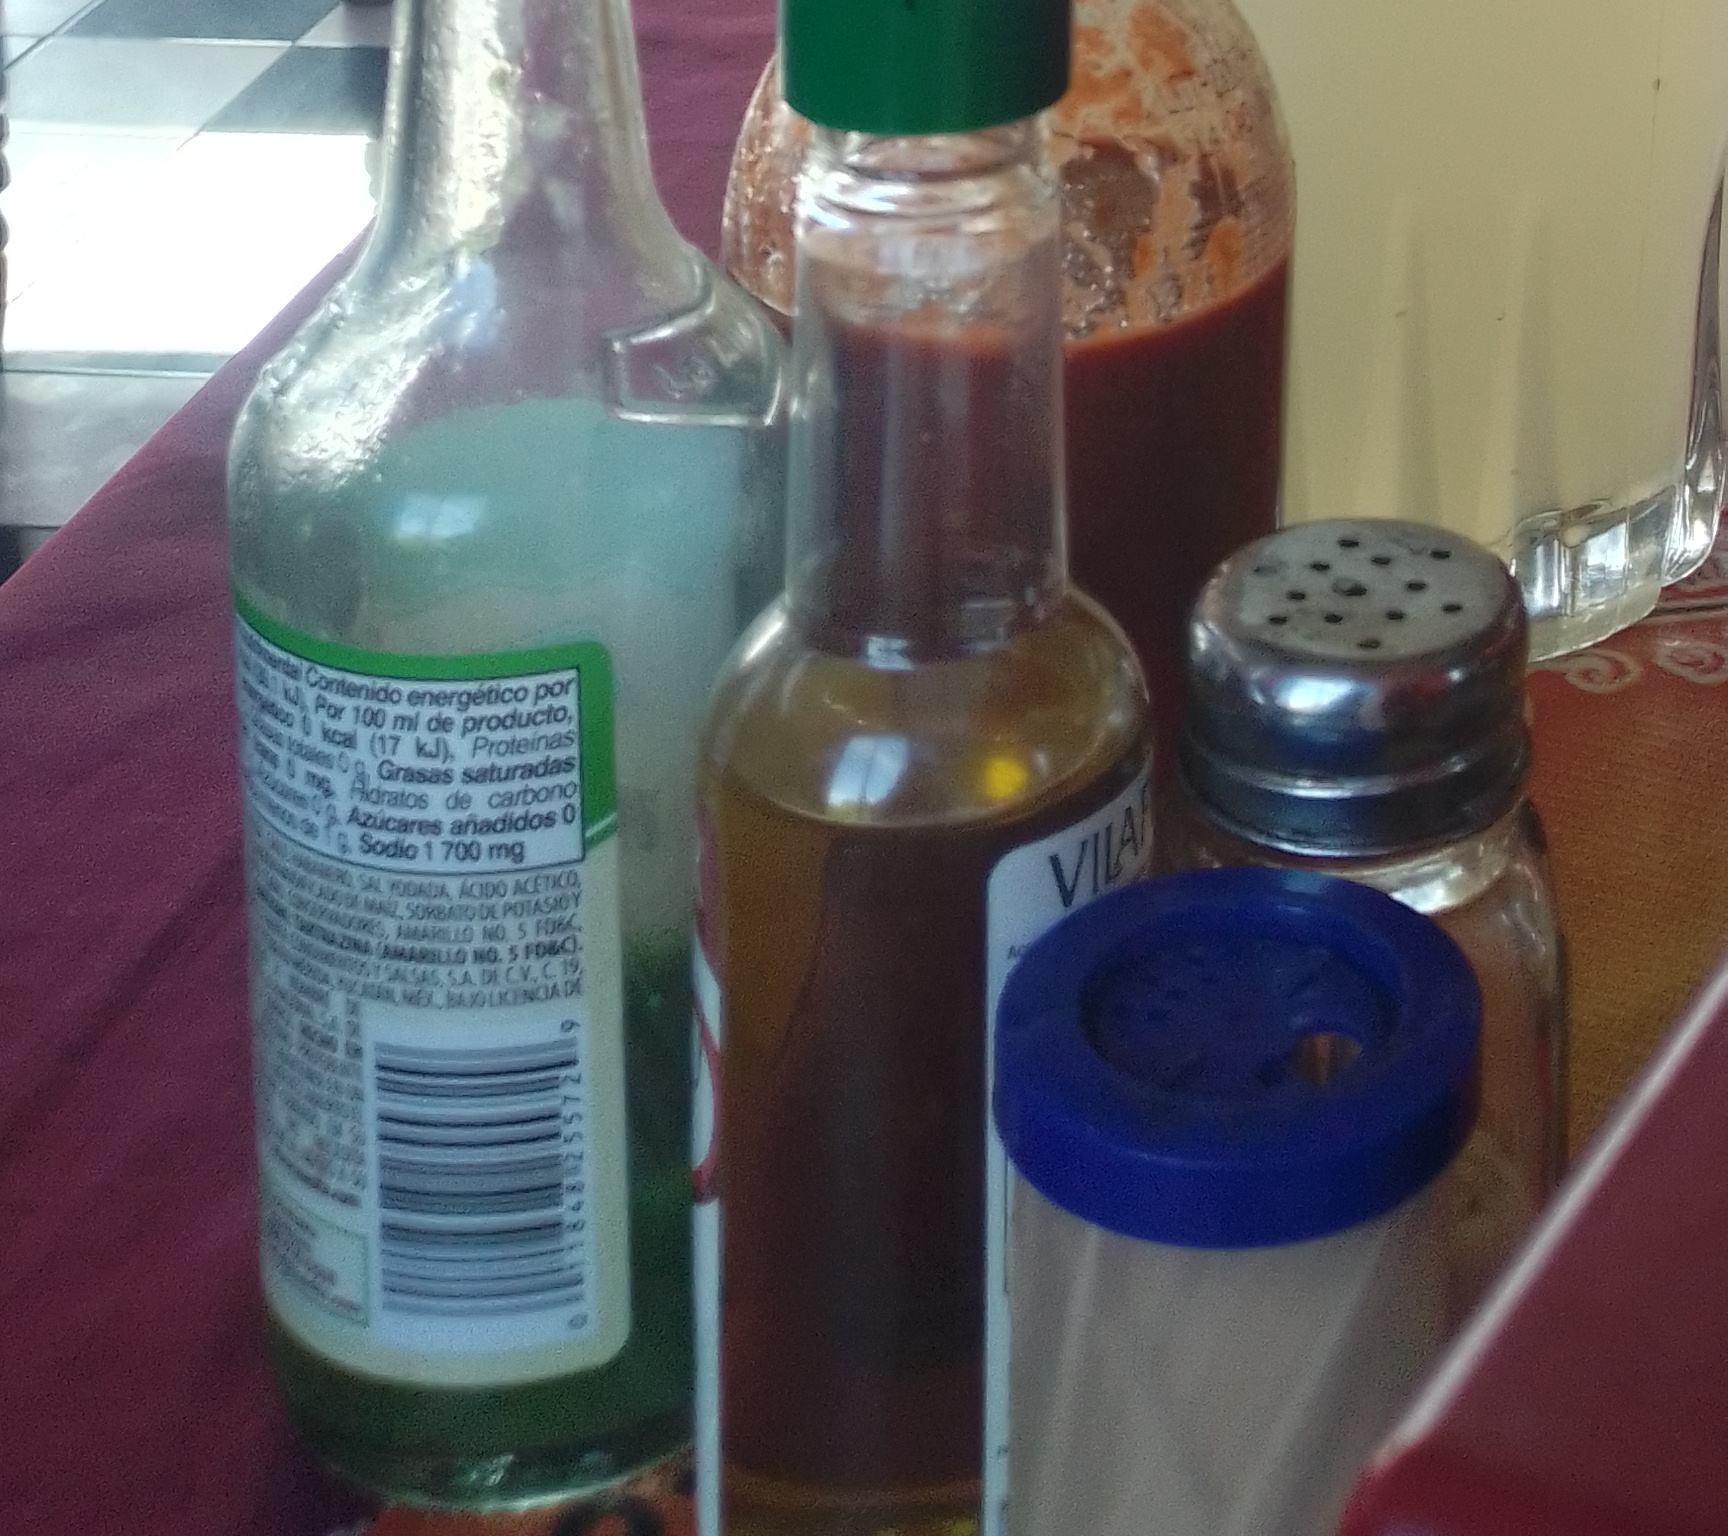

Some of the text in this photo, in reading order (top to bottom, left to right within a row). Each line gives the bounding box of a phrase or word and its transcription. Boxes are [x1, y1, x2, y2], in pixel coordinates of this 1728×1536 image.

[305, 666, 402, 705] Contenido
[407, 683, 528, 712] energético
[534, 677, 575, 707] por
[315, 693, 346, 720] Por
[355, 707, 386, 728] 100
[393, 711, 420, 732] ml
[427, 711, 455, 733] de
[461, 704, 572, 739] producto,
[322, 724, 358, 749] kcal
[370, 732, 401, 758] (17
[472, 730, 575, 758] Proteínas
[378, 759, 454, 784] Grasas
[461, 754, 577, 784] saturadas
[446, 789, 472, 810] de
[488, 780, 578, 809] carbono
[347, 806, 443, 836] Azúcares
[451, 809, 557, 835] añadidos
[562, 802, 576, 824] 0
[360, 831, 419, 861] Sodio
[440, 839, 481, 862] 700
[488, 840, 525, 864] mg
